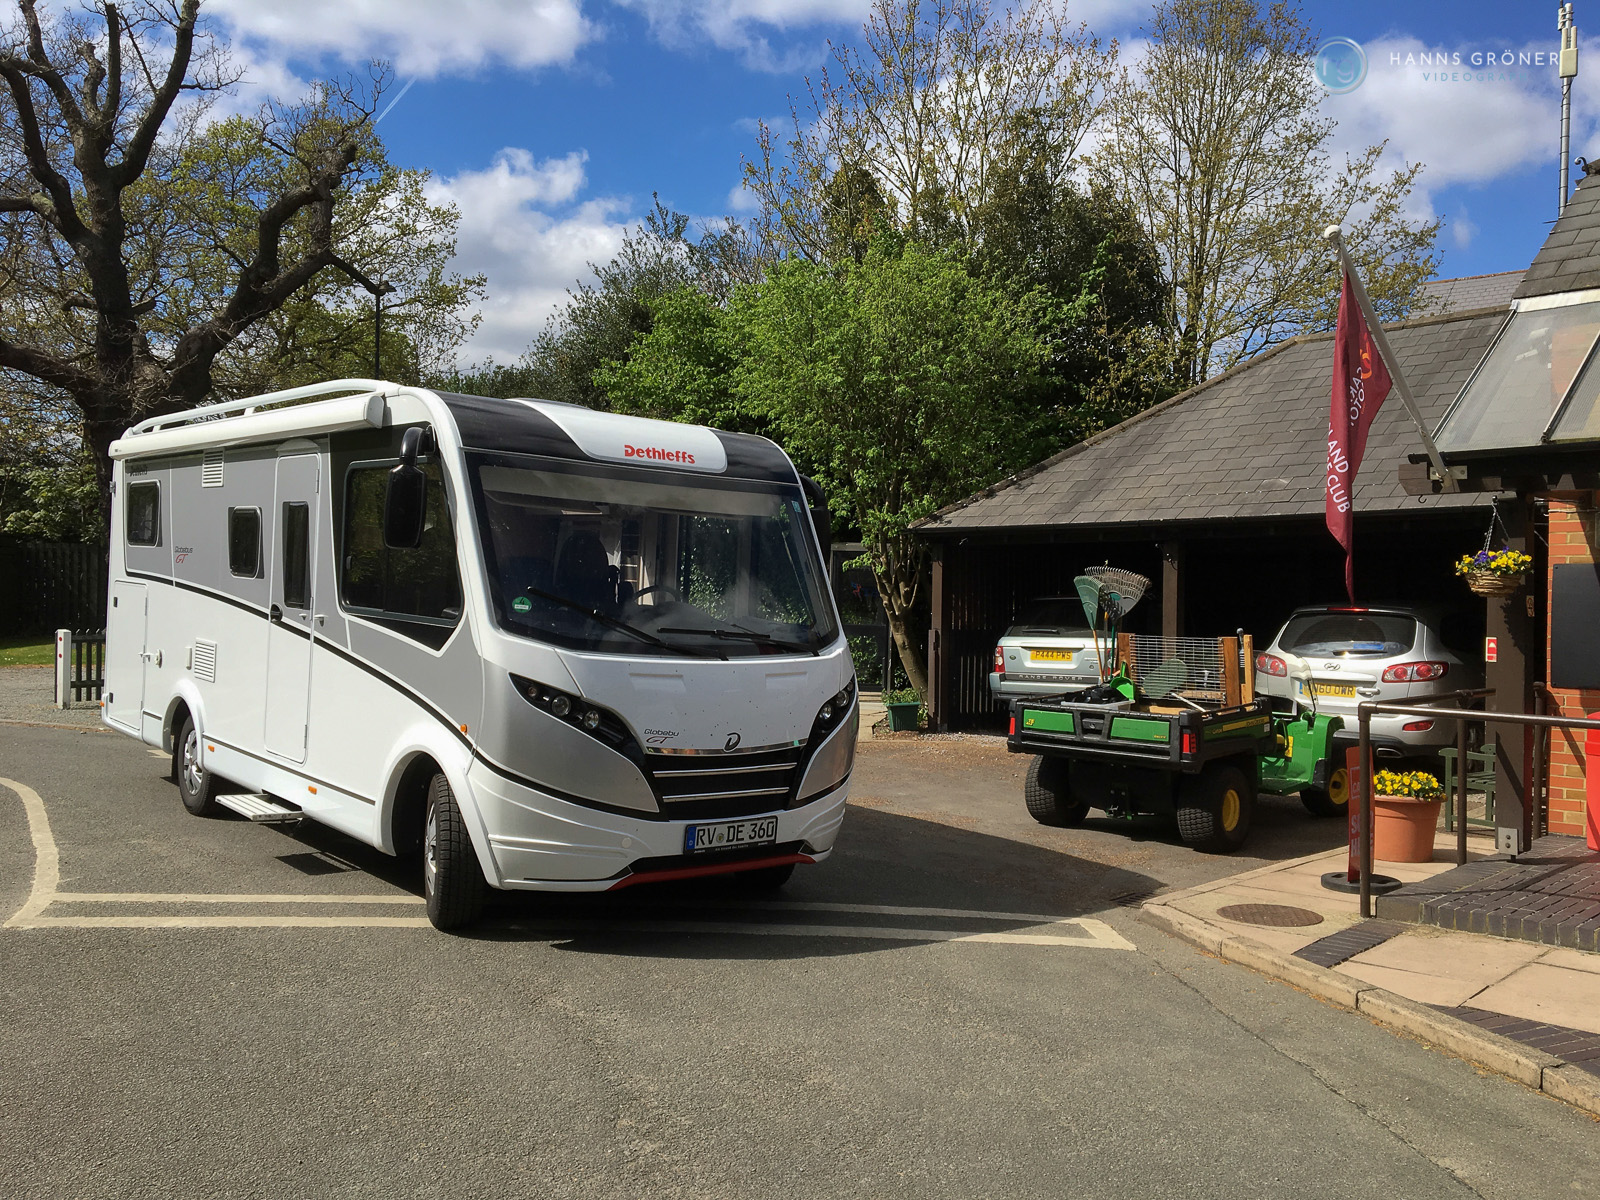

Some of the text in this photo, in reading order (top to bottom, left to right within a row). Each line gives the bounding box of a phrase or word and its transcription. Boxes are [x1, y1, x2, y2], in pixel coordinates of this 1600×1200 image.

[624, 444, 696, 464] Dethleffs
[1328, 440, 1349, 473] AND
[1327, 474, 1350, 513] CLUB
[695, 821, 775, 847] RV DE 360
